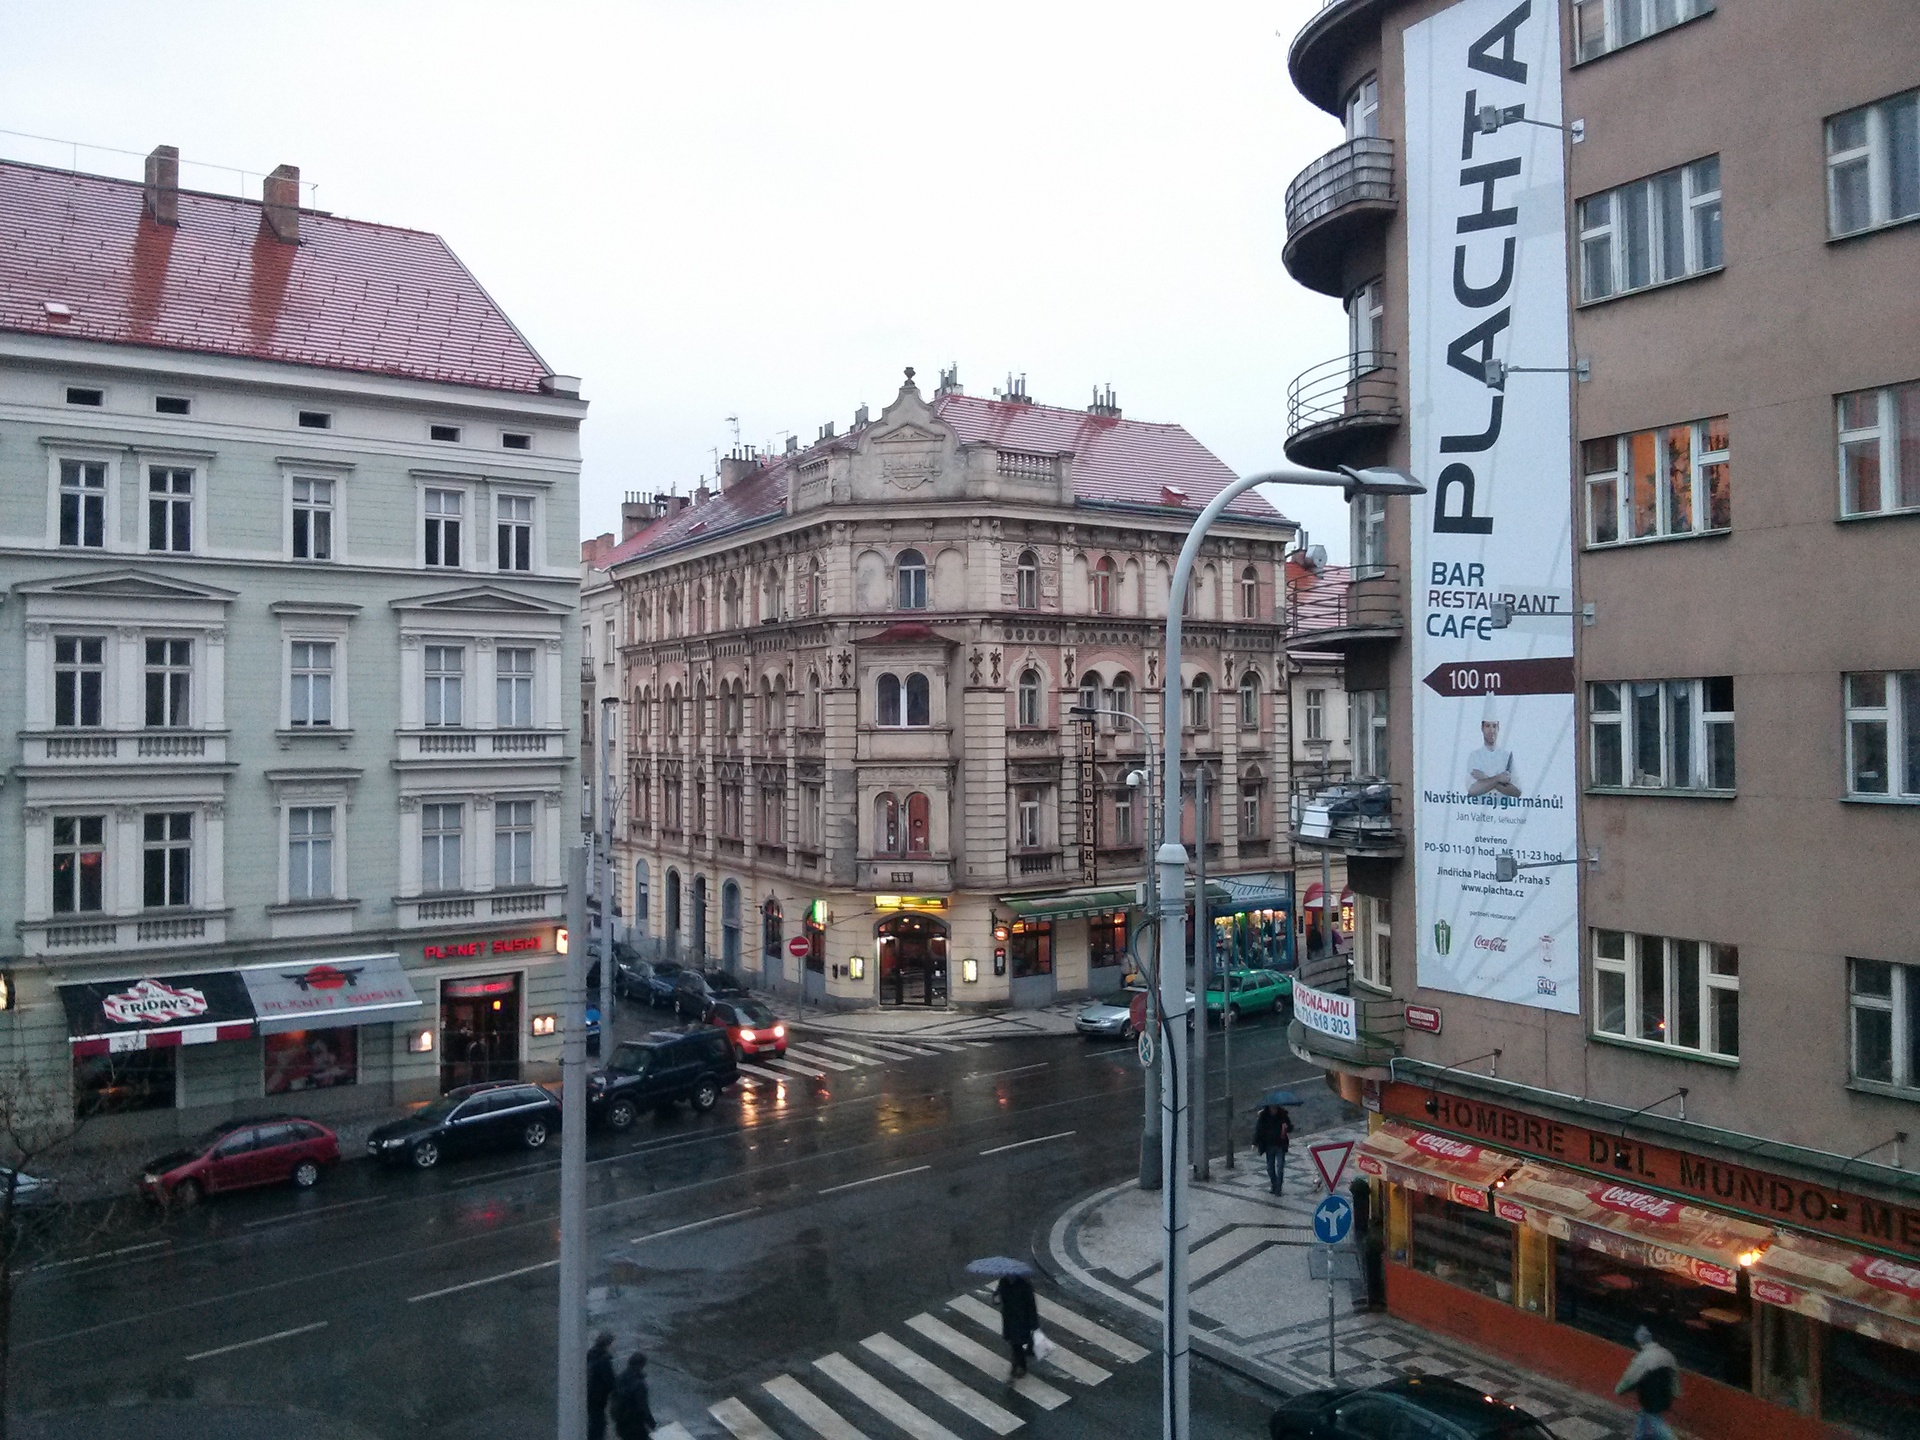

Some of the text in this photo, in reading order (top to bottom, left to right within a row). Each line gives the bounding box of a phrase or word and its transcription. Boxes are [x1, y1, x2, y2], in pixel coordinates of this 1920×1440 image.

[1433, 0, 1532, 535] PLACHTA
[1430, 561, 1485, 587] BAR
[1427, 589, 1560, 613] RESTAURANT
[1426, 613, 1492, 641] CAFE
[1448, 669, 1501, 690] 100 m
[1424, 790, 1564, 811] Navštivte ráj gurmánů!
[1456, 811, 1470, 821] Jan
[1424, 841, 1451, 853] PO-SO
[1453, 845, 1476, 855] 11-01
[1516, 849, 1542, 860] 11-23
[1474, 835, 1508, 845] otevřeno
[1437, 866, 1472, 878] Jindřicha
[1519, 874, 1544, 886] Praha
[1544, 876, 1551, 886] 5
[1461, 882, 1525, 898] www.plachta.cz
[424, 936, 542, 960] PLANET SUSHI
[1330, 1017, 1351, 1036] 303
[1433, 1095, 1565, 1154] HOMBRE
[1588, 1133, 1656, 1179] DEL
[1680, 1152, 1828, 1222] MUNDO
